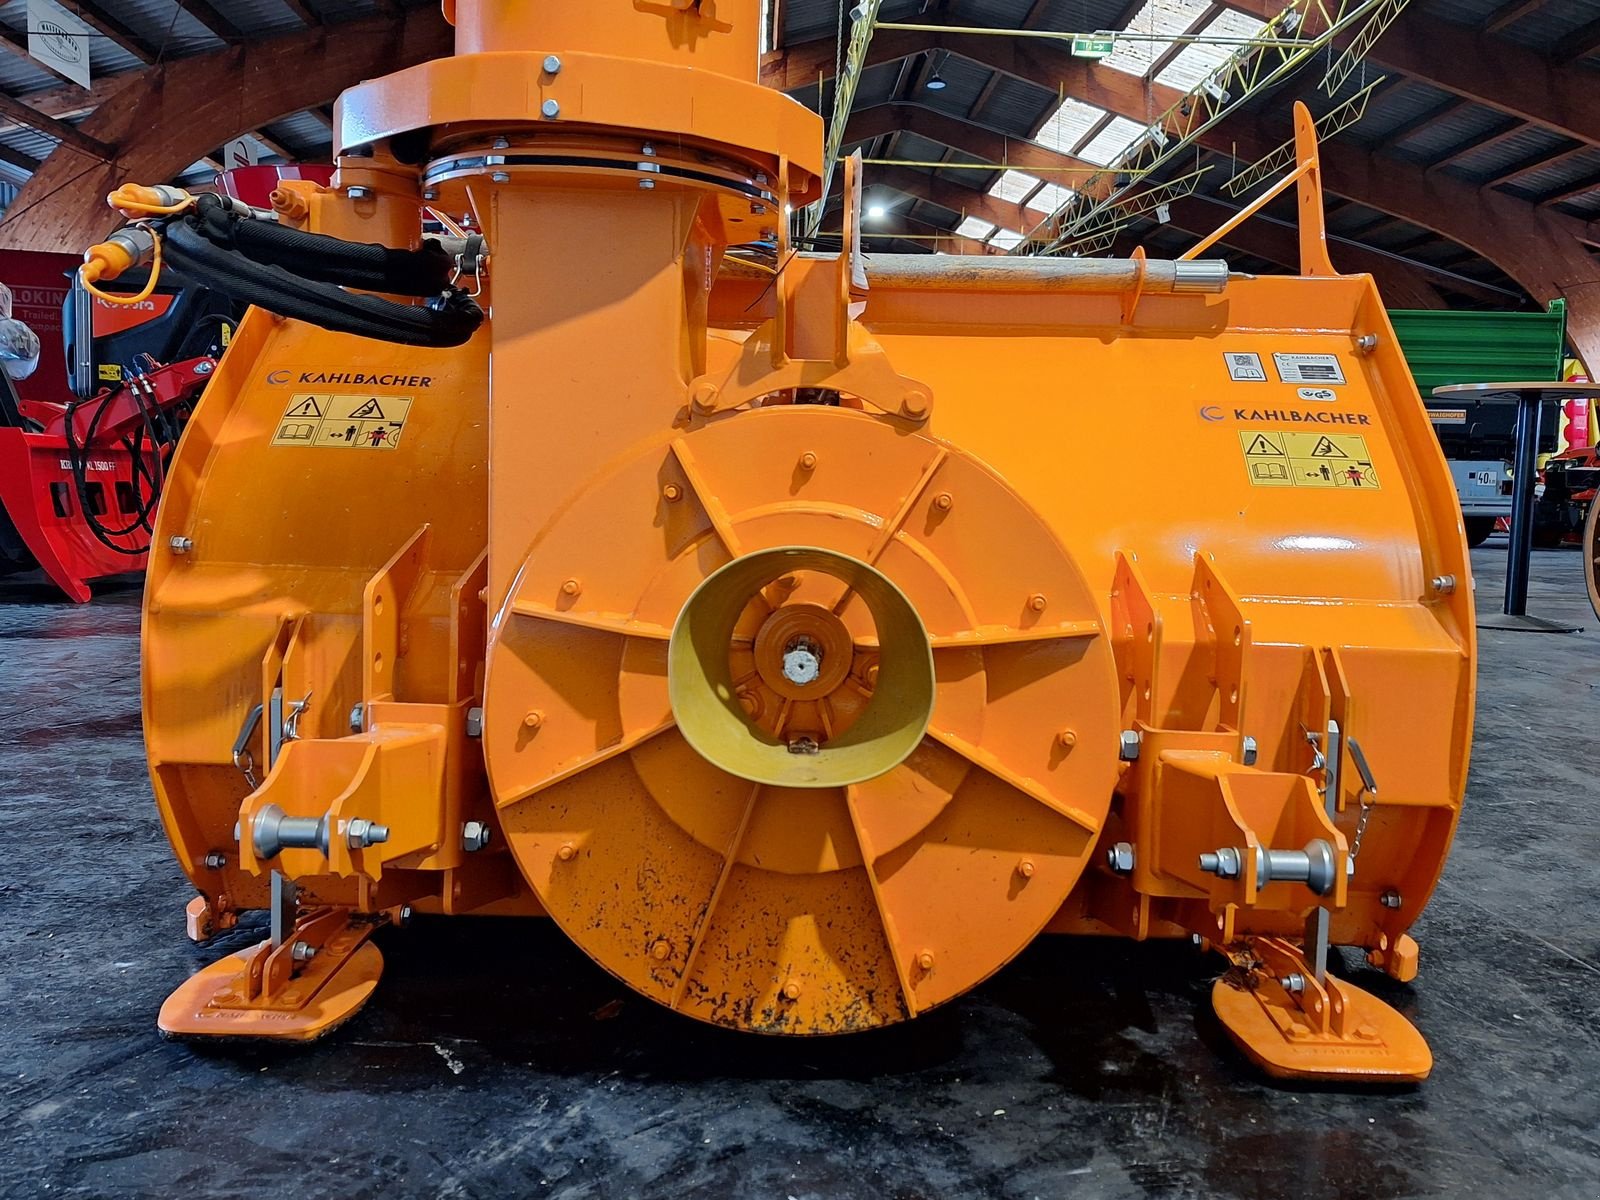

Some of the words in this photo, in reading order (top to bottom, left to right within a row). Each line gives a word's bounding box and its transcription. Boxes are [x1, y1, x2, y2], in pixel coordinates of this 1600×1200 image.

[12, 289, 64, 305] LOKIN
[298, 372, 432, 388] KAHLBACHER
[1233, 408, 1372, 426] KAHLBACHER
[1478, 472, 1489, 484] 40
